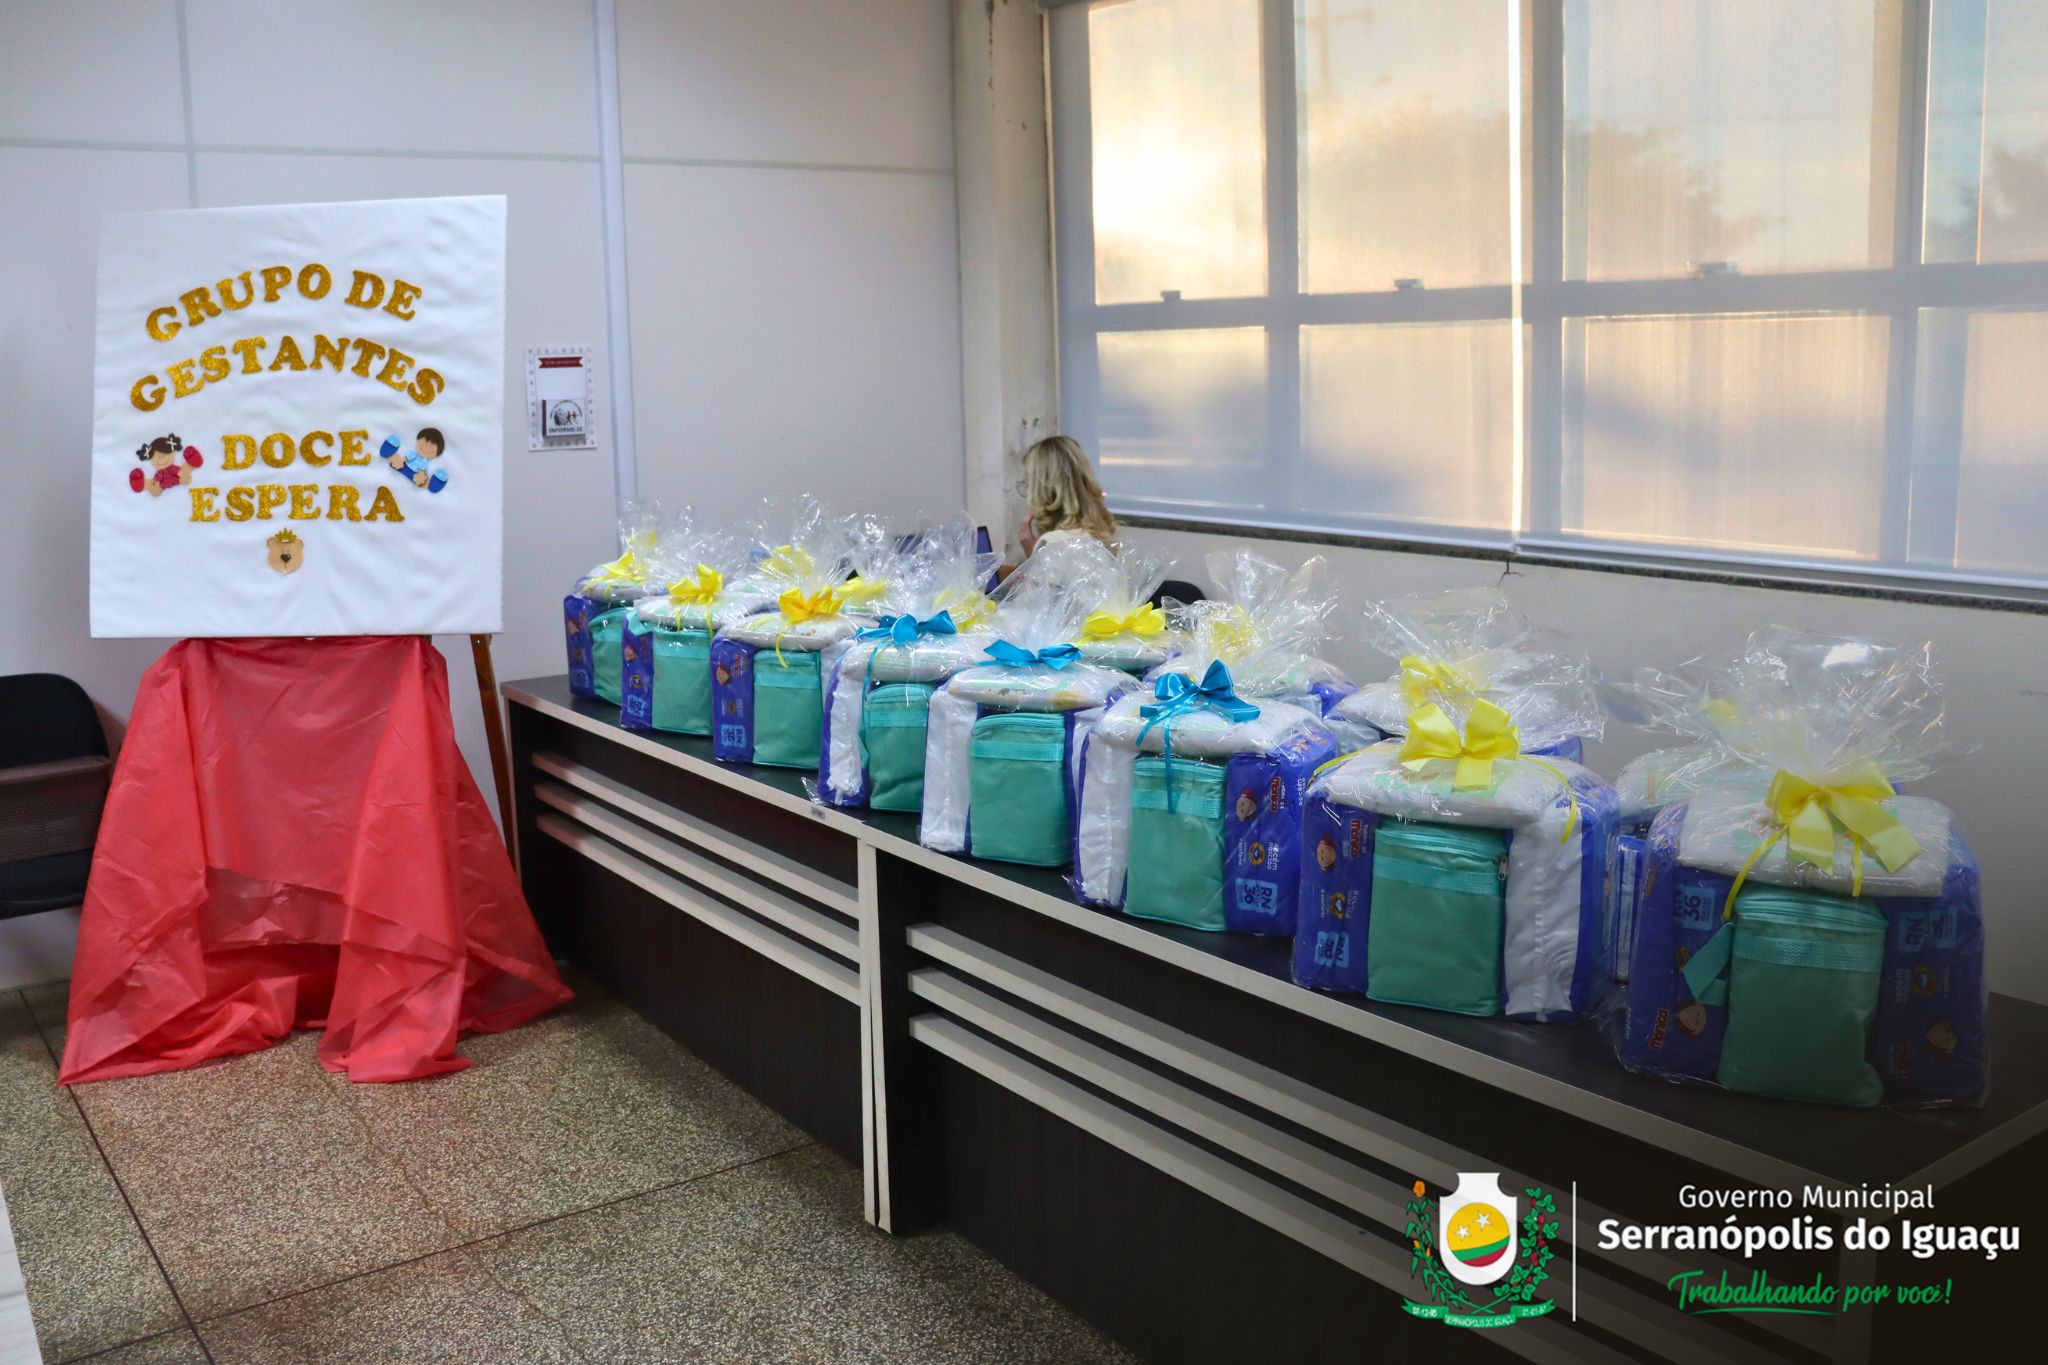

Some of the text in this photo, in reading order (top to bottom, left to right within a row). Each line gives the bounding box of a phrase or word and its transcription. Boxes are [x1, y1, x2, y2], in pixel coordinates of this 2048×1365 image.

[145, 263, 423, 342] GRUPO DE
[131, 334, 445, 412] GESTANTES
[220, 430, 372, 471] DOCE
[189, 485, 405, 523] ESPERA
[1244, 884, 1256, 904] 36
[1261, 887, 1273, 910] RN
[1683, 895, 1701, 922] 36
[1905, 917, 1924, 945] RN
